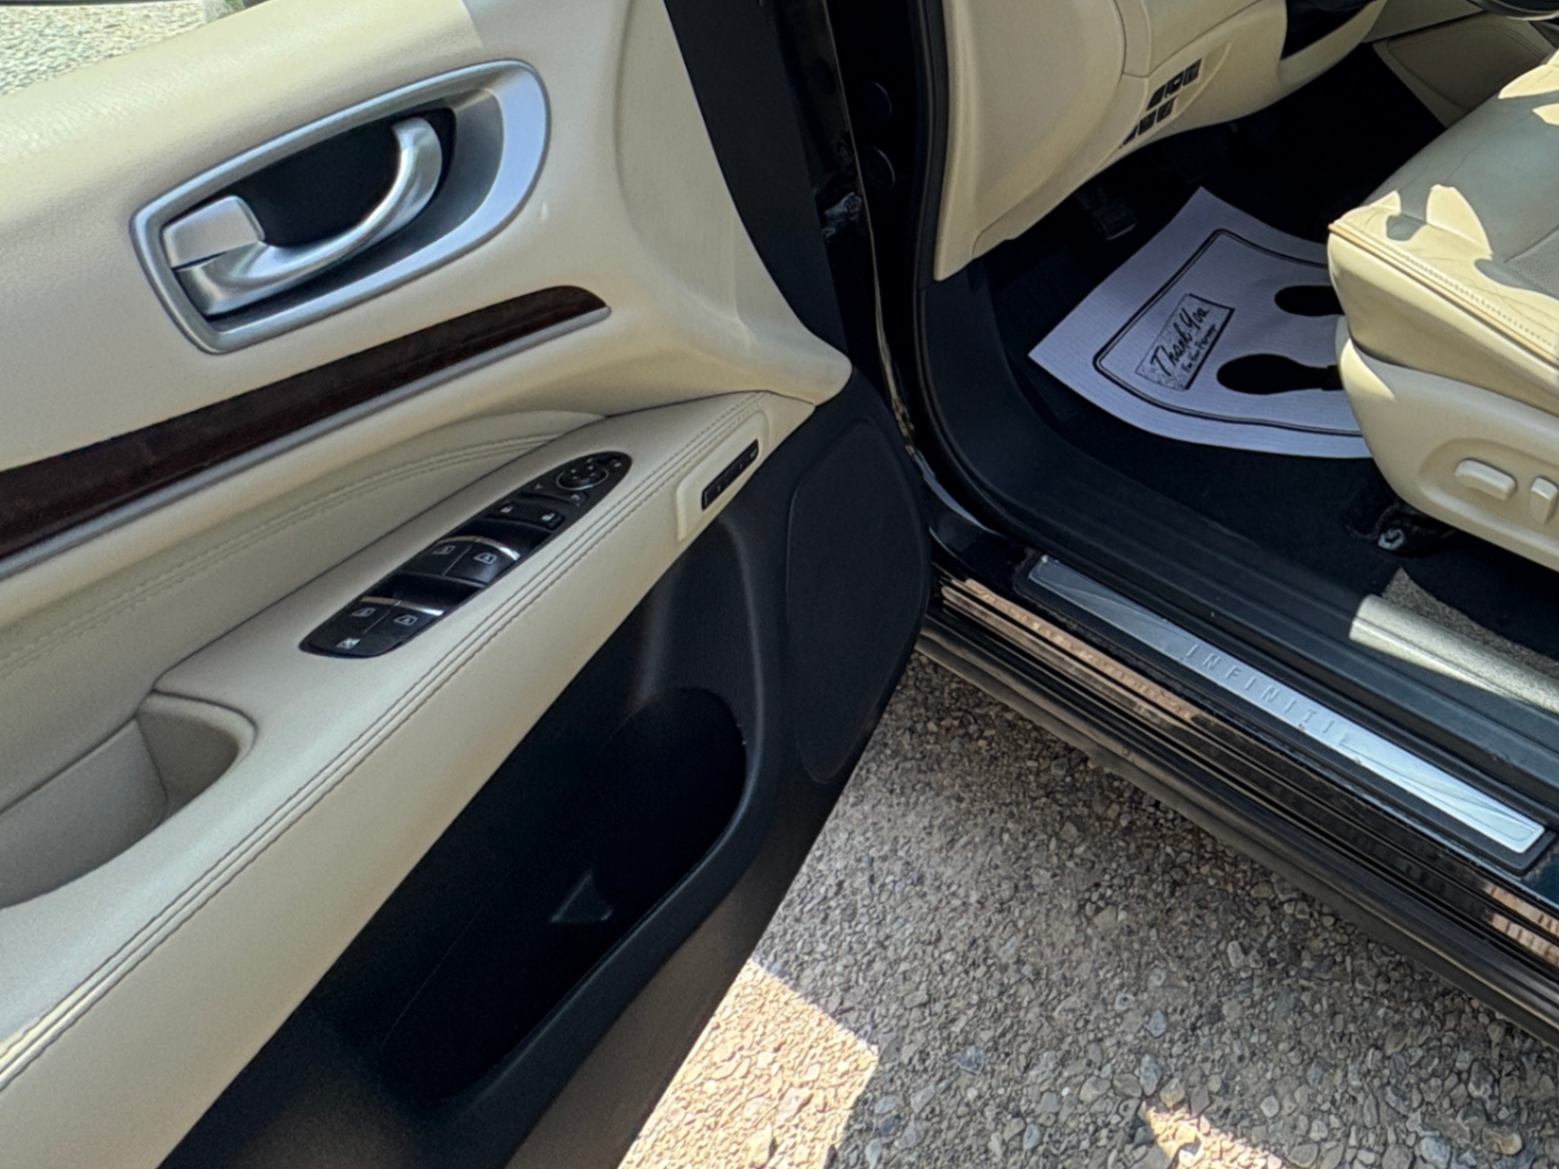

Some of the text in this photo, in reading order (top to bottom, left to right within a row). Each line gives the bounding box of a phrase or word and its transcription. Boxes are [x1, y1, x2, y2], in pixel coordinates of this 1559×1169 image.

[1149, 322, 1194, 377] Thank
[1179, 307, 1210, 331] You
[1185, 643, 1335, 734] INFINITI
